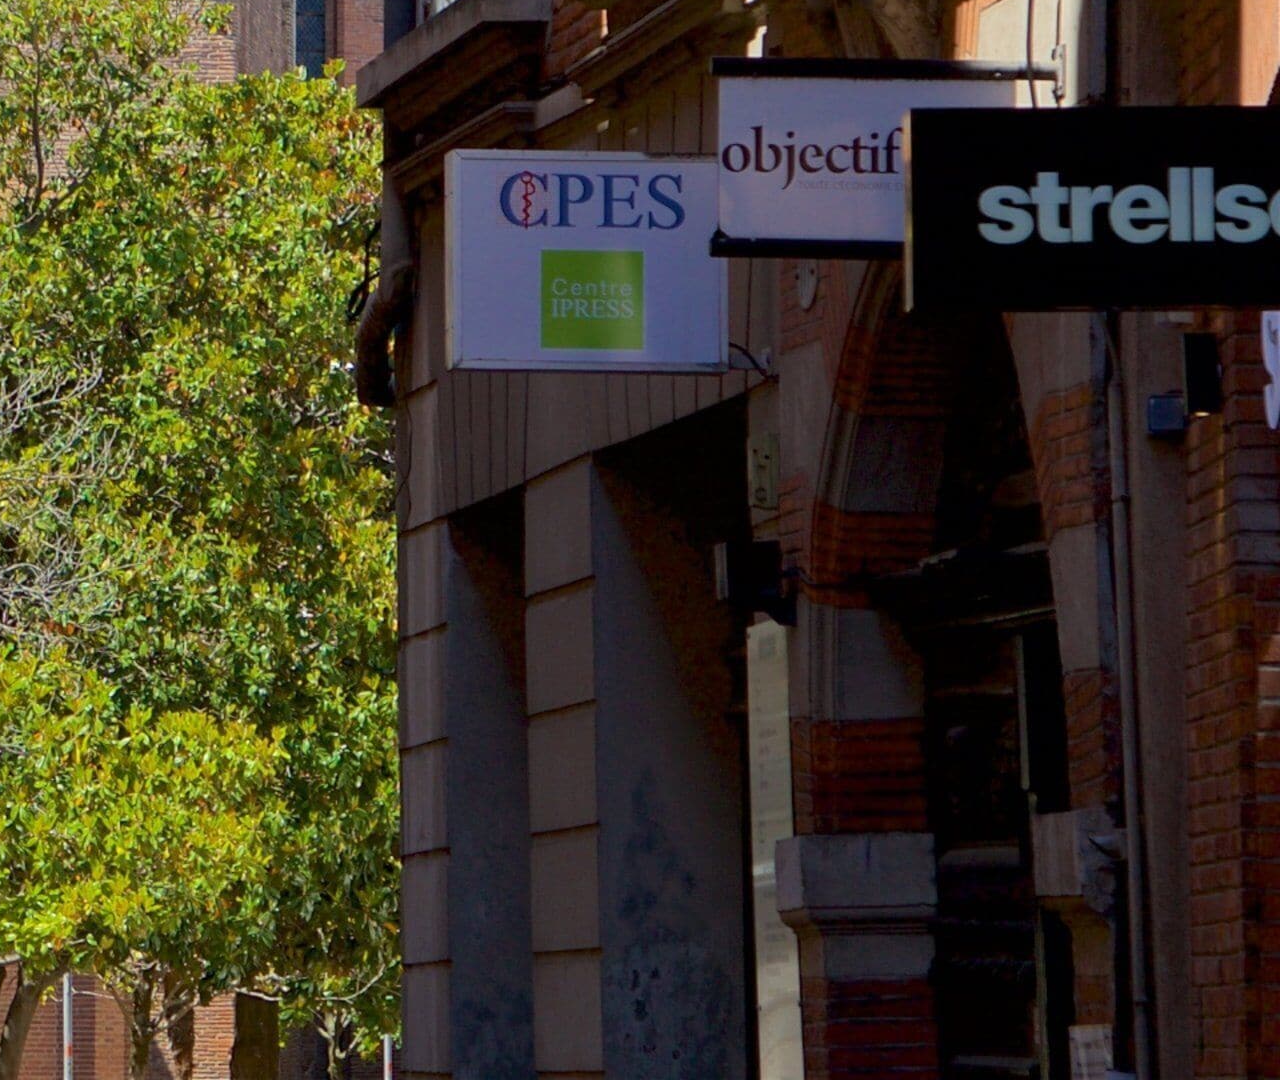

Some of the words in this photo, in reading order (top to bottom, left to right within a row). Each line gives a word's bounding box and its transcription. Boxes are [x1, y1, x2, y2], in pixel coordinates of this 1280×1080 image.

[722, 125, 903, 191] objectif
[499, 170, 686, 230] CPES
[977, 166, 1280, 245] strells
[551, 278, 633, 296] Centre
[551, 299, 635, 319] IPRESS
